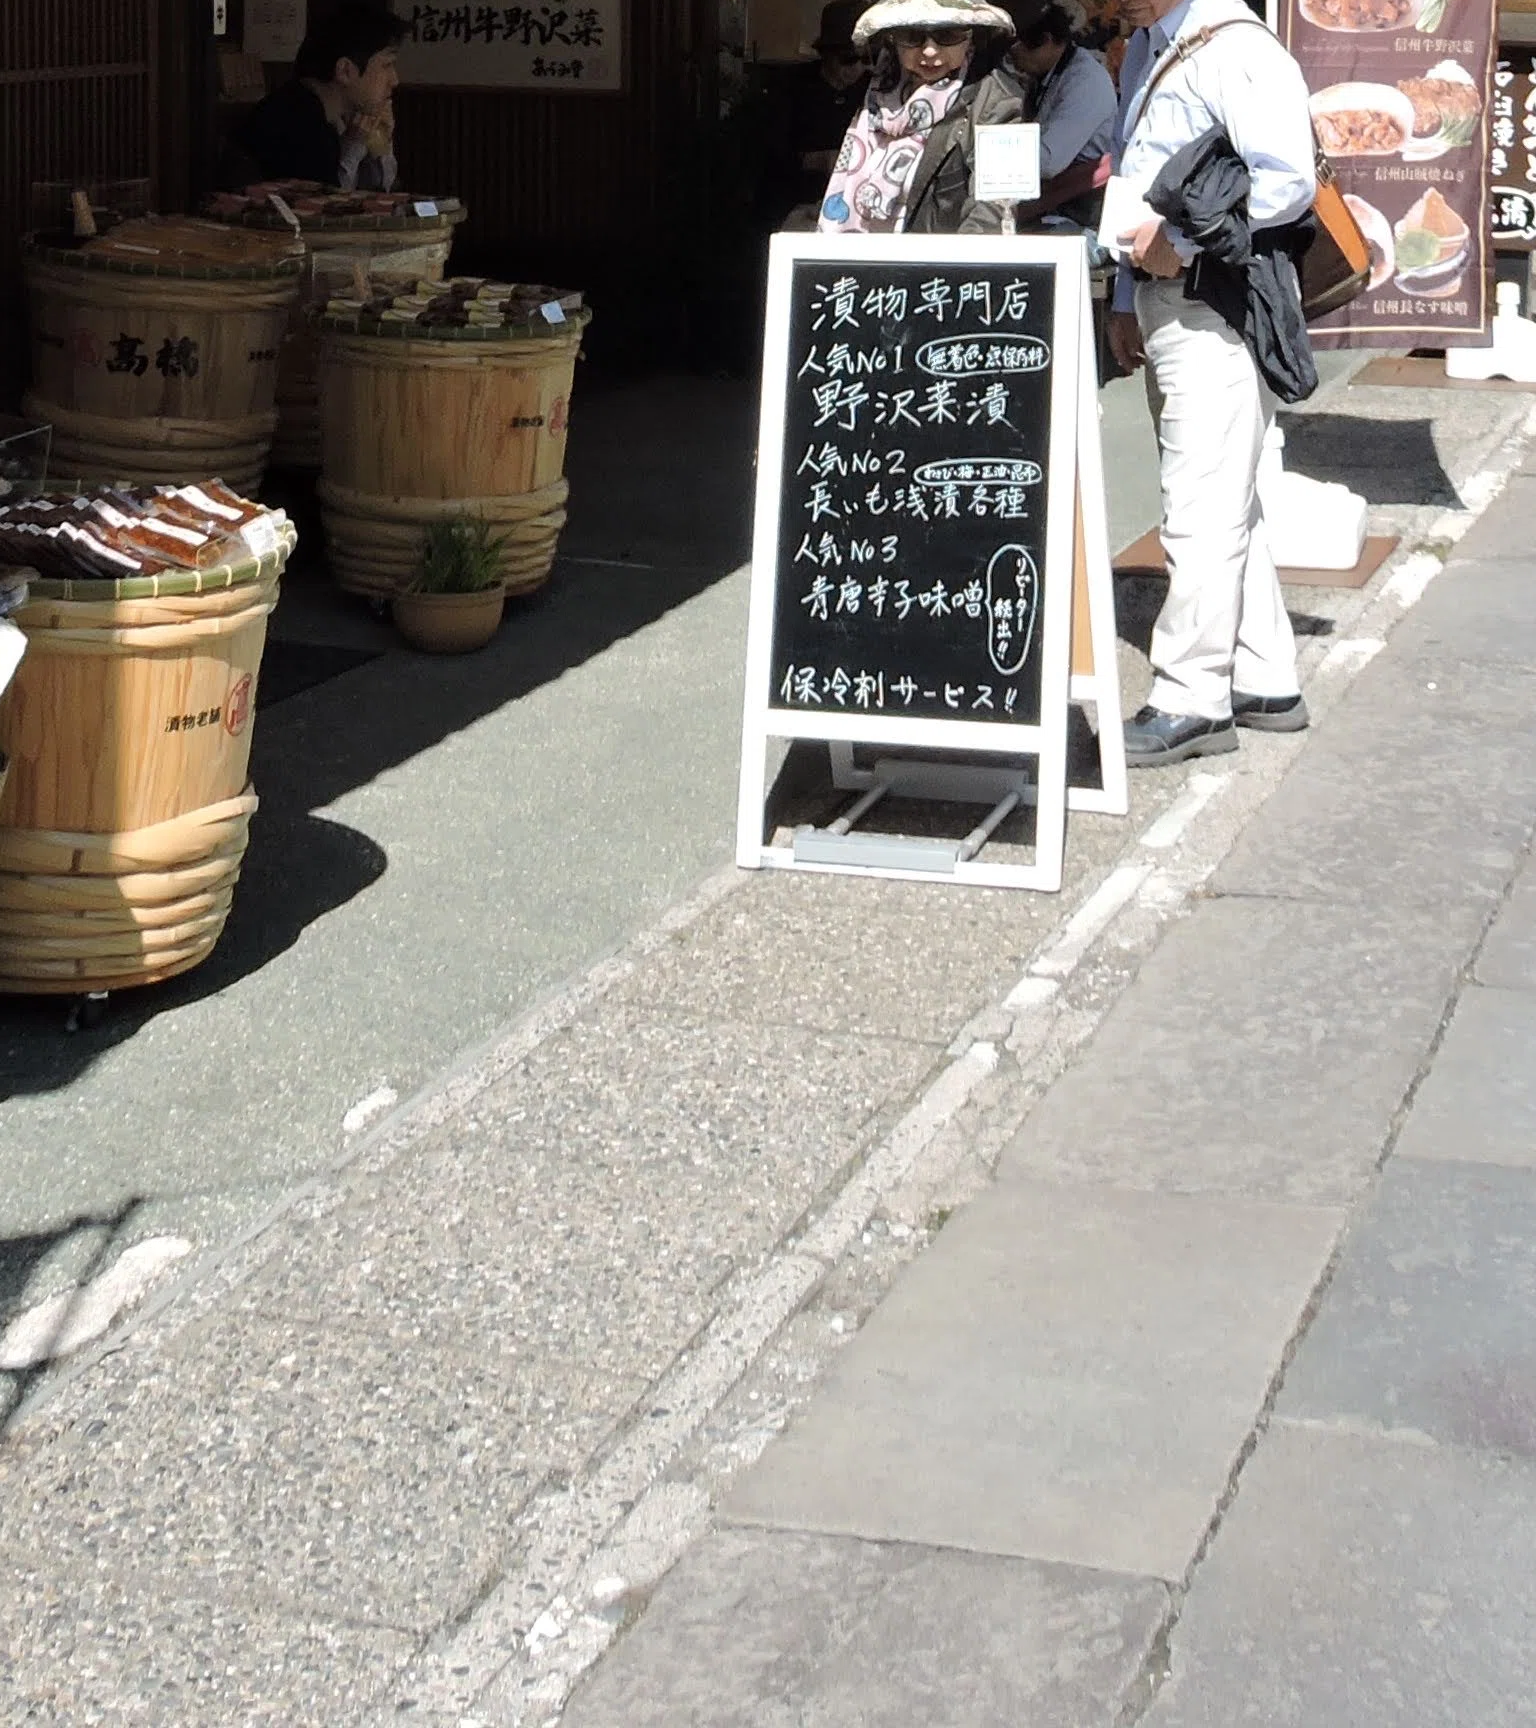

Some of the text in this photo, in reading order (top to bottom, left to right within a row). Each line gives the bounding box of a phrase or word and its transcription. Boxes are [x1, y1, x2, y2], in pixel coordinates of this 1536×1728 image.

[410, 3, 604, 47] 信州牛野沢菜
[810, 275, 1031, 331] 漬物専門店
[811, 378, 1015, 431] 野沢菜漬
[800, 574, 985, 621] 青唐辛子味噌
[1015, 557, 1032, 632] リピーター
